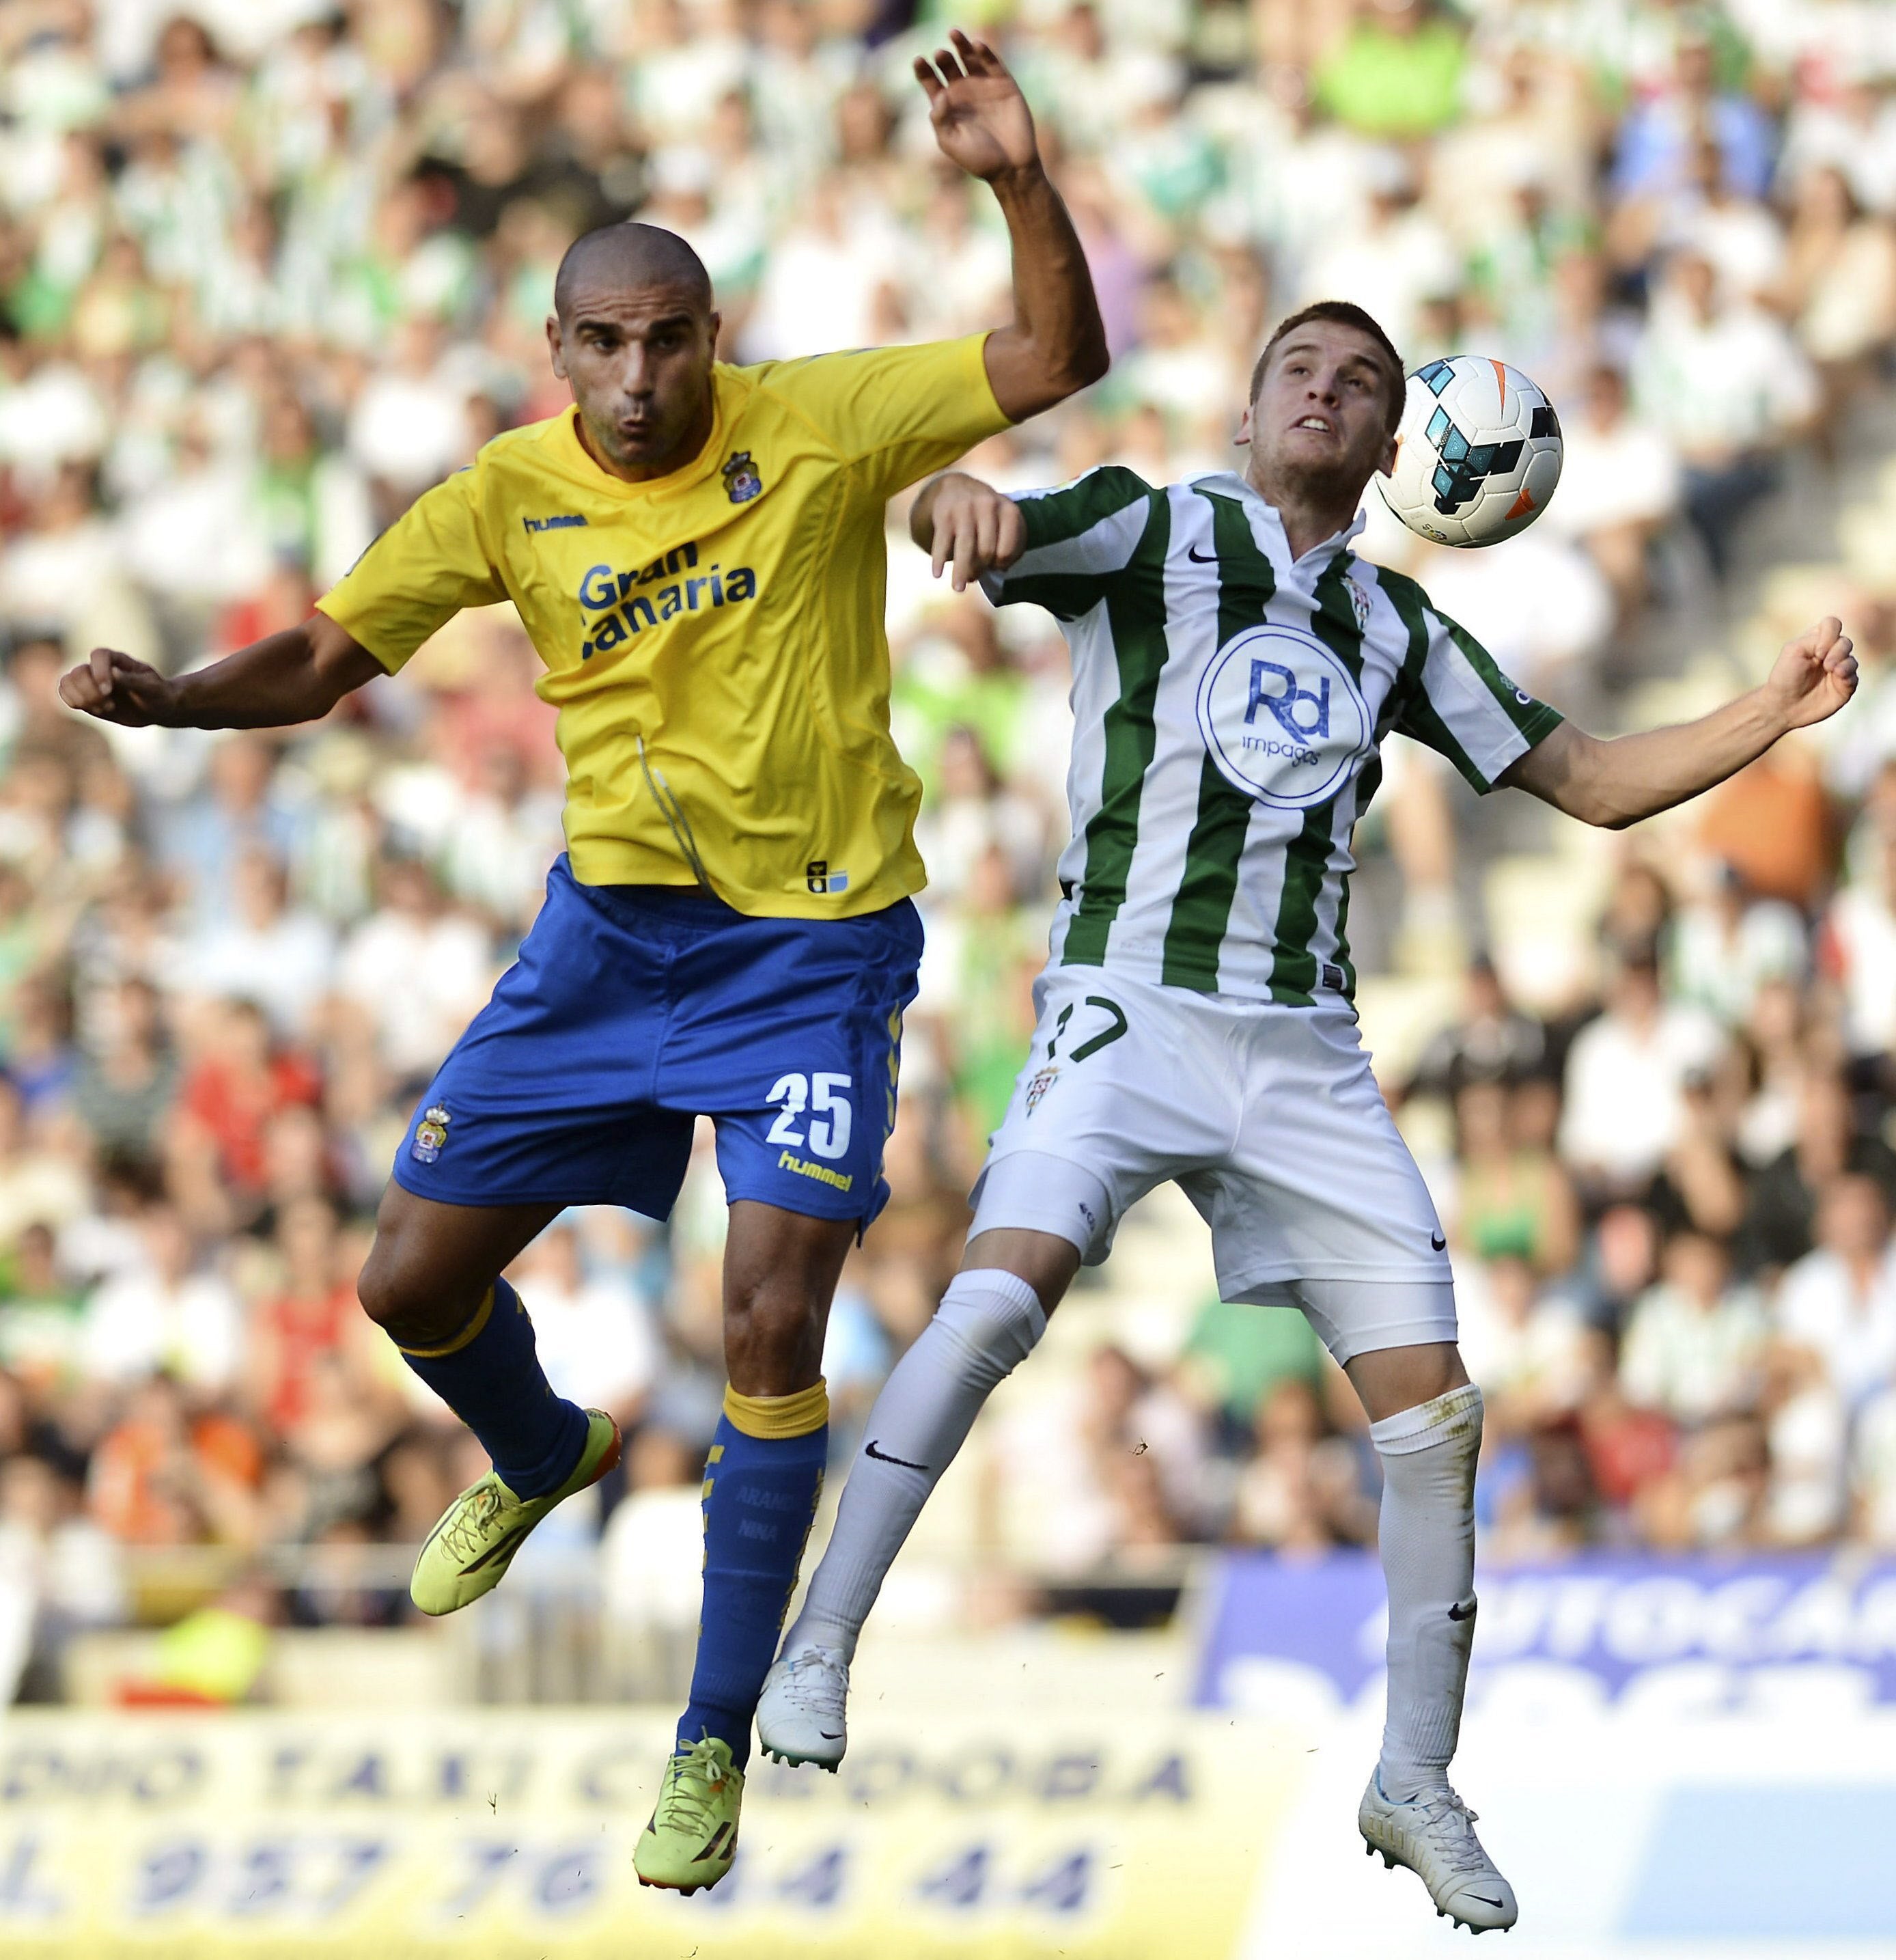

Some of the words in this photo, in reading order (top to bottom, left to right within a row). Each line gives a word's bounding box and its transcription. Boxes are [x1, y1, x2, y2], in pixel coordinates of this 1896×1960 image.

[579, 541, 698, 610] Gran
[1244, 659, 1330, 745] Rd
[765, 1072, 852, 1160] 25
[777, 1150, 853, 1191] hummel
